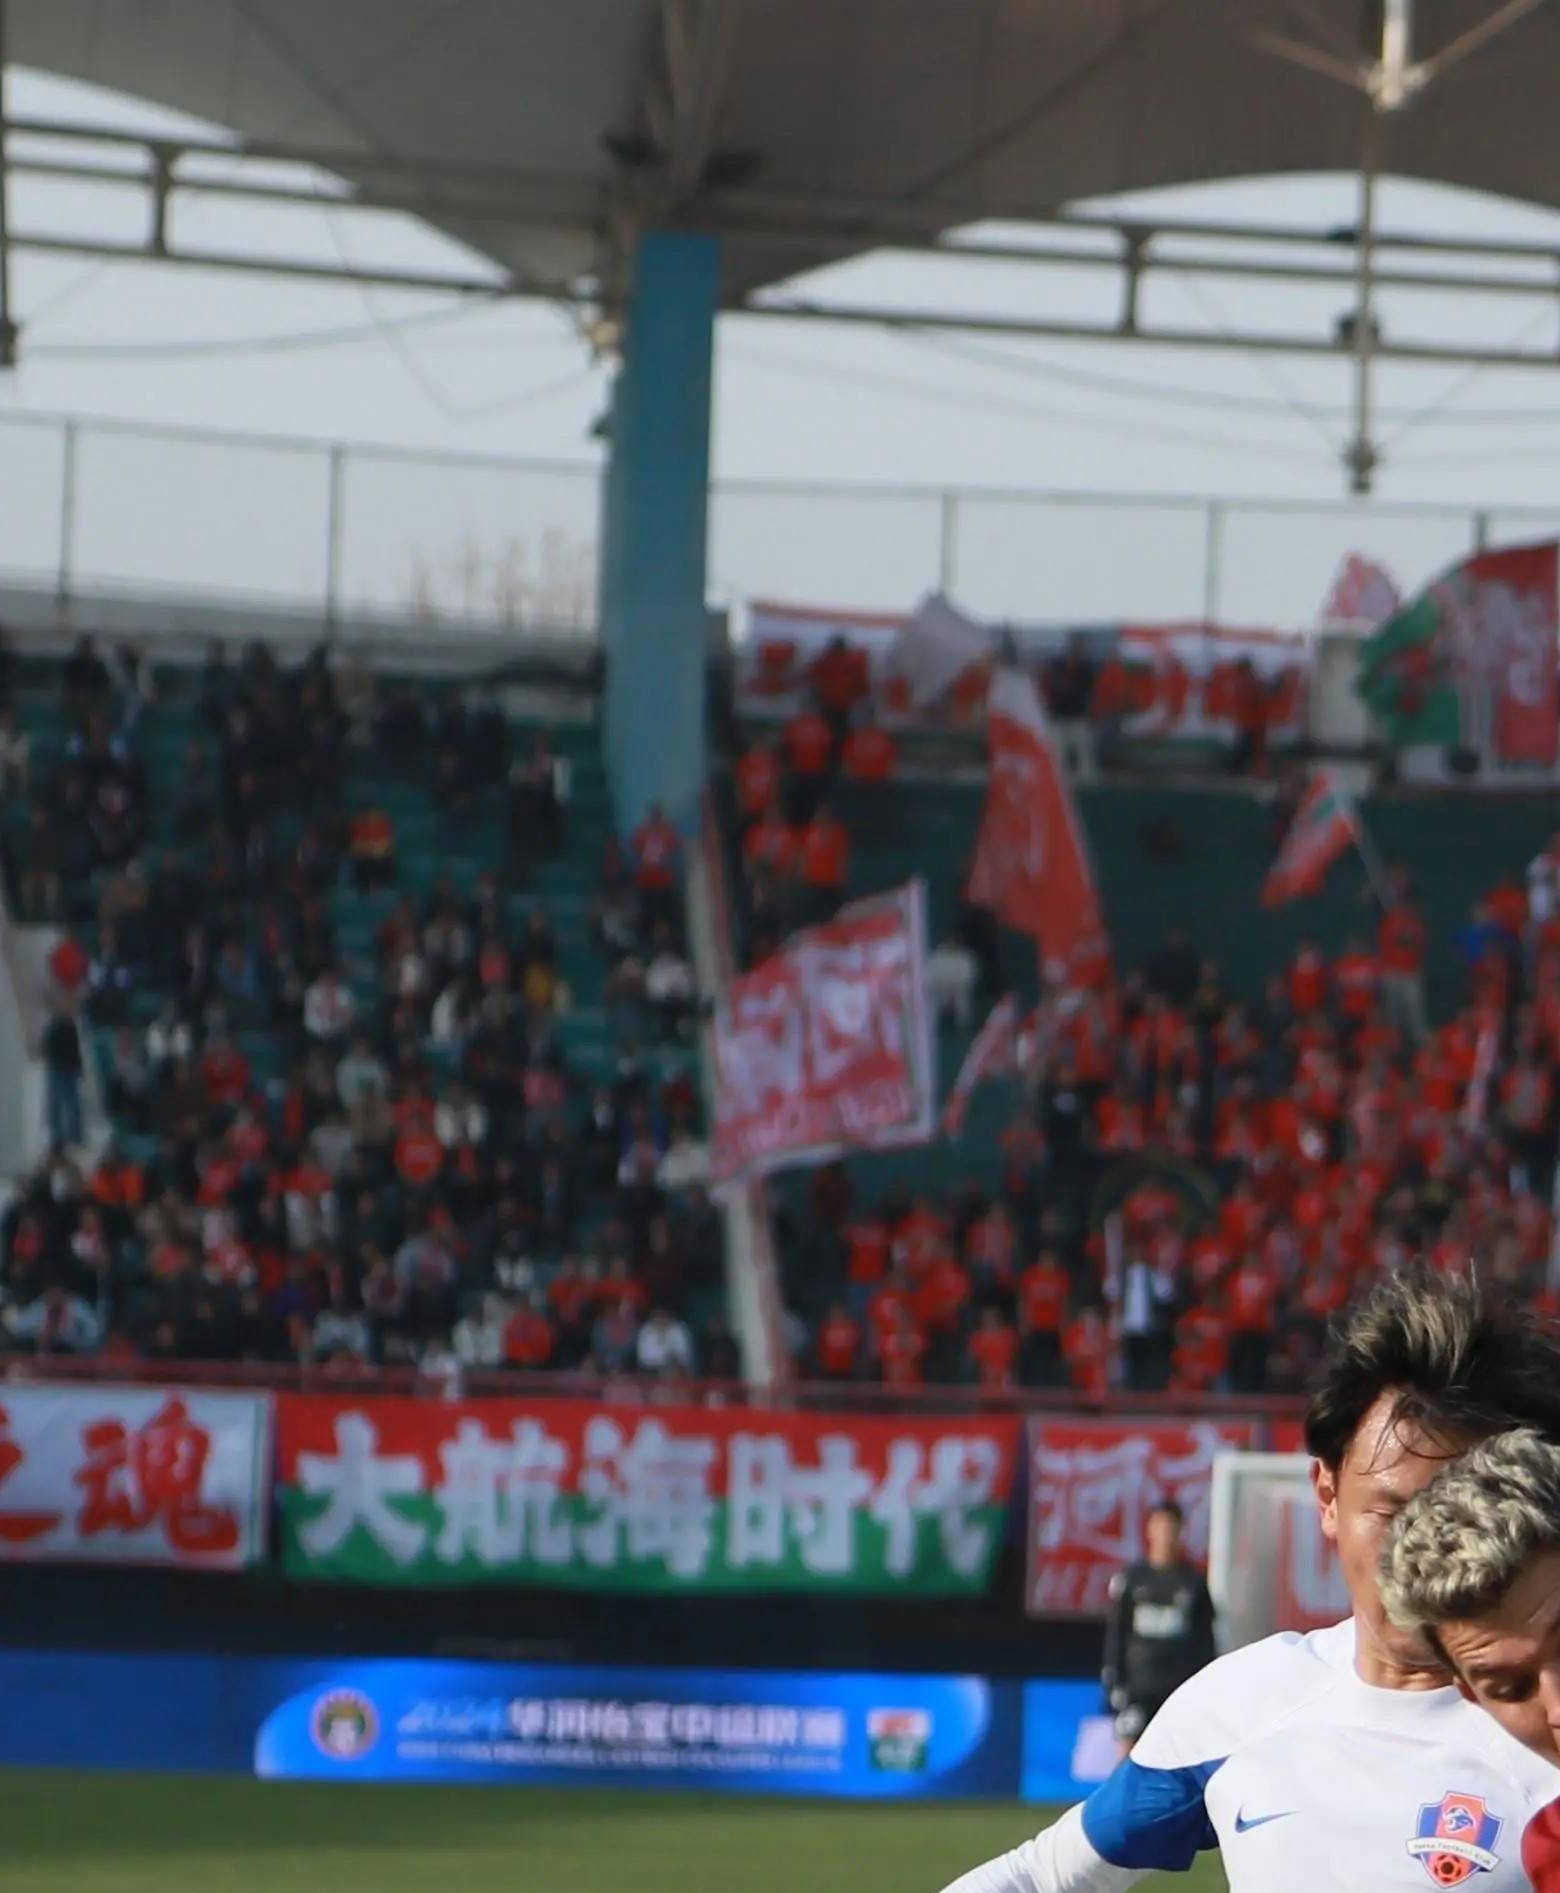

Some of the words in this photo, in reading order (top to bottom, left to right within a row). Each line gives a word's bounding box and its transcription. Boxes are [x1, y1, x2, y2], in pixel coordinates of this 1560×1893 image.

[296, 1410, 1002, 1576] 大航海时代
